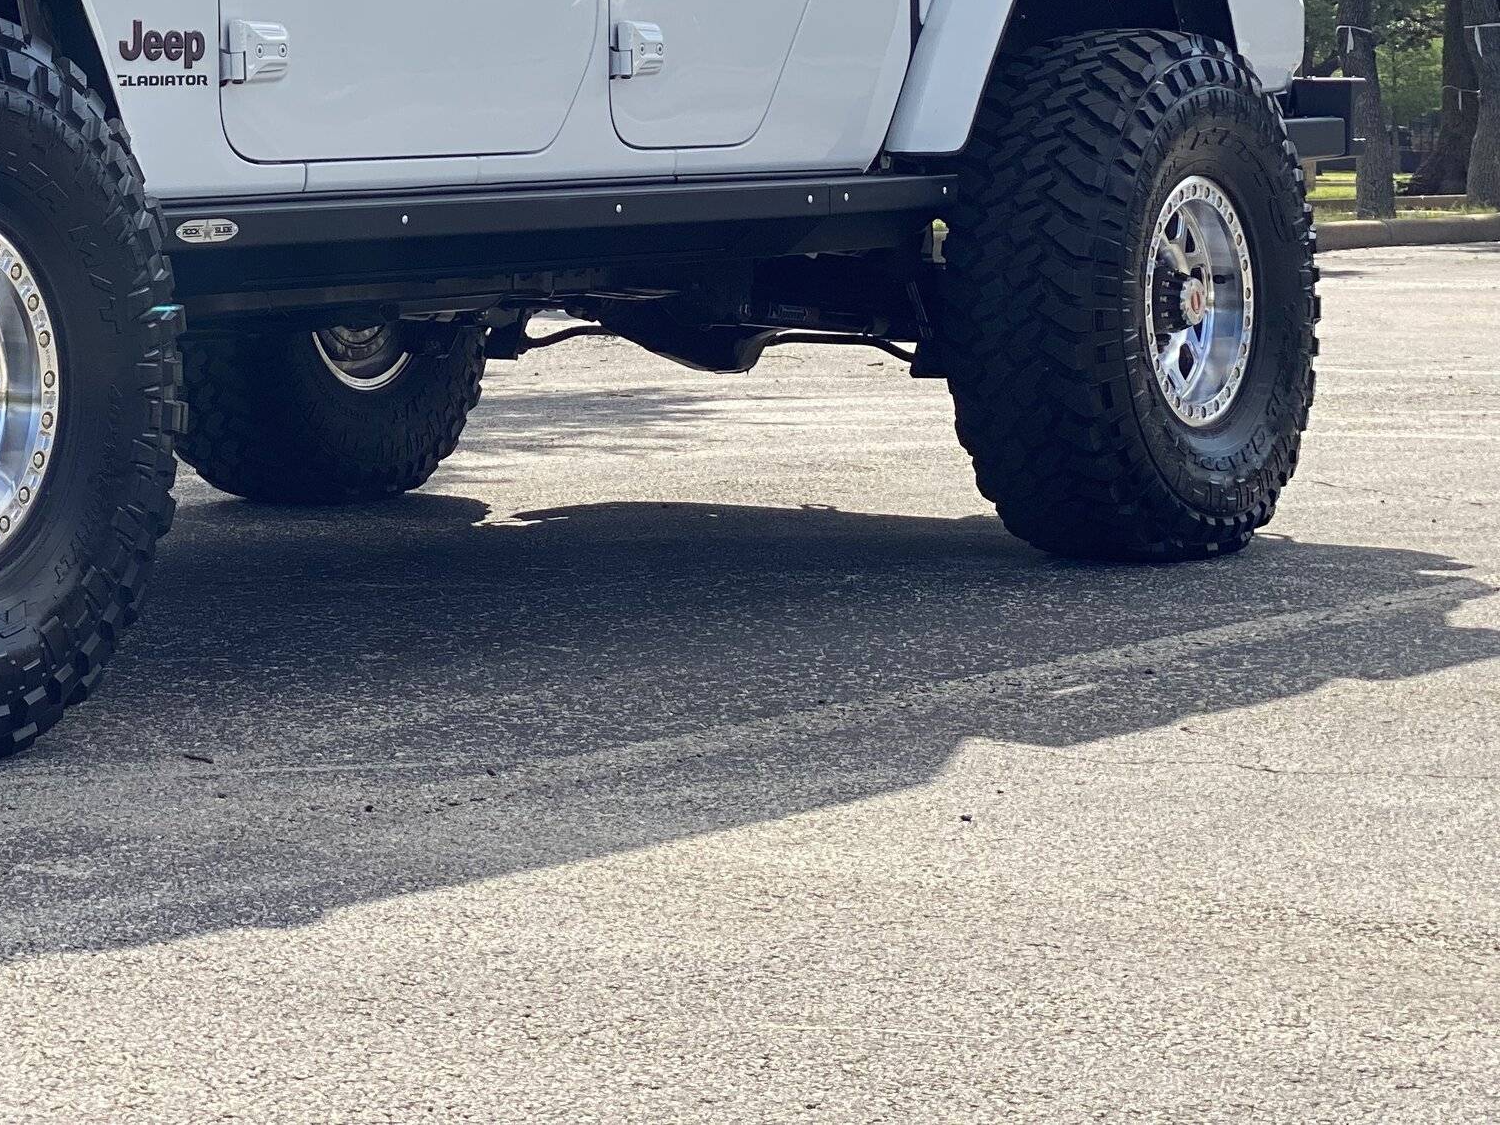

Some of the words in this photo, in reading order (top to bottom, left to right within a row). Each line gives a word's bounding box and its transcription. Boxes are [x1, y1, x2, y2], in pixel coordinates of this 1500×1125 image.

[119, 20, 205, 69] Jeep
[117, 75, 208, 86] GLADIATOR
[182, 228, 201, 236] ROCK
